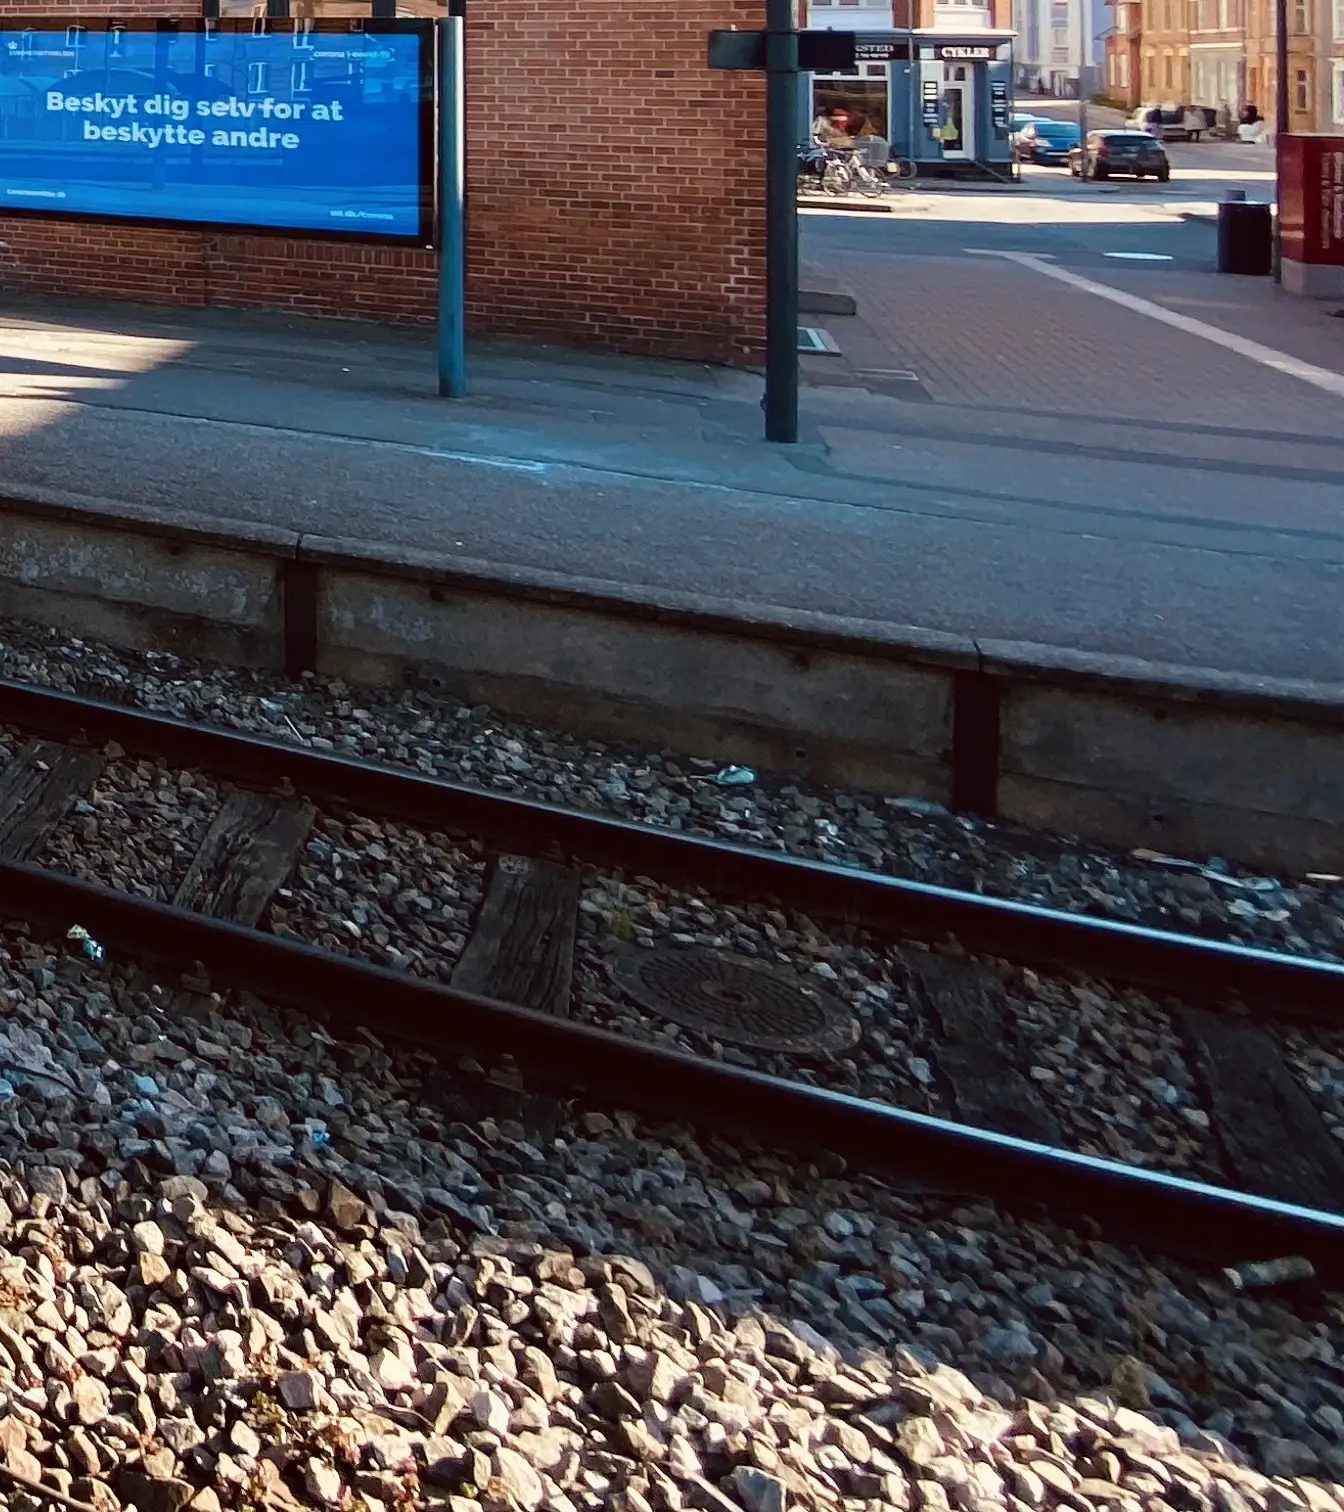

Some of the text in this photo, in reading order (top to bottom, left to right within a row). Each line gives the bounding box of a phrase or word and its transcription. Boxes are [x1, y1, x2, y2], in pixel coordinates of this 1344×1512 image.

[941, 46, 990, 58] CYKLER
[46, 91, 344, 121] Beskyt dig selv for at
[83, 120, 300, 149] beskytte andre
